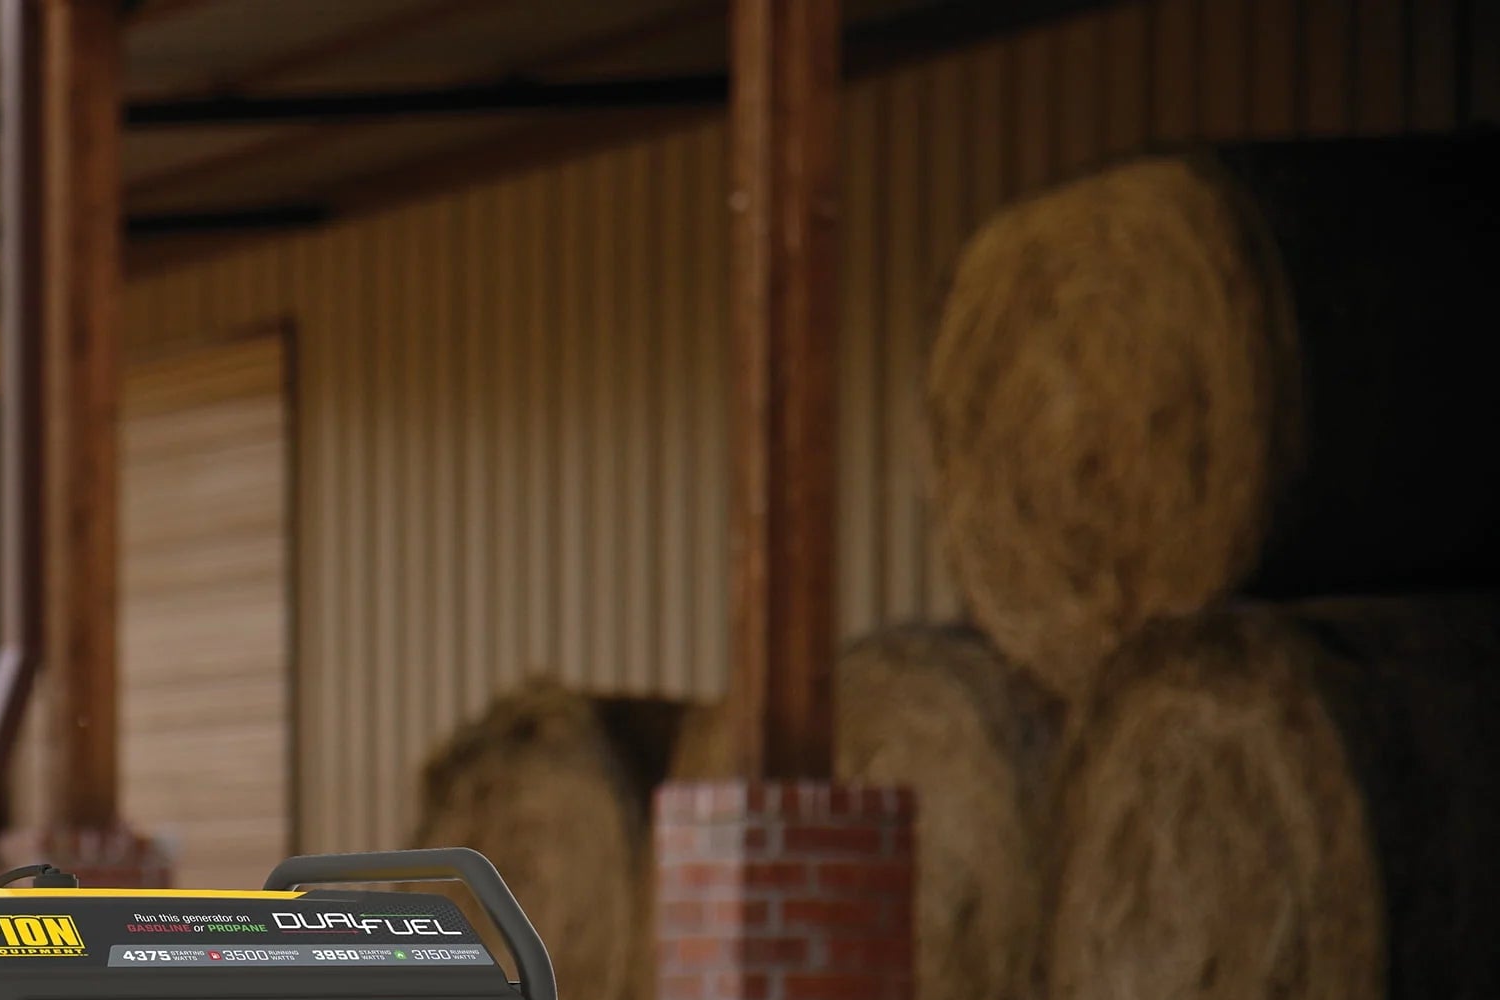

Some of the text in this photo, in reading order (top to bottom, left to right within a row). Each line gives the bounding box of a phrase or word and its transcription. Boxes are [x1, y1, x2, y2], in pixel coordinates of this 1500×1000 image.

[134, 913, 157, 922] Run
[159, 913, 180, 922] this
[182, 913, 233, 924] generator
[127, 924, 268, 933] GASOLINE or PROPANE
[122, 950, 171, 961] 4375
[222, 950, 269, 961] 3500
[312, 950, 359, 960] 3950
[411, 950, 451, 960] 3150
